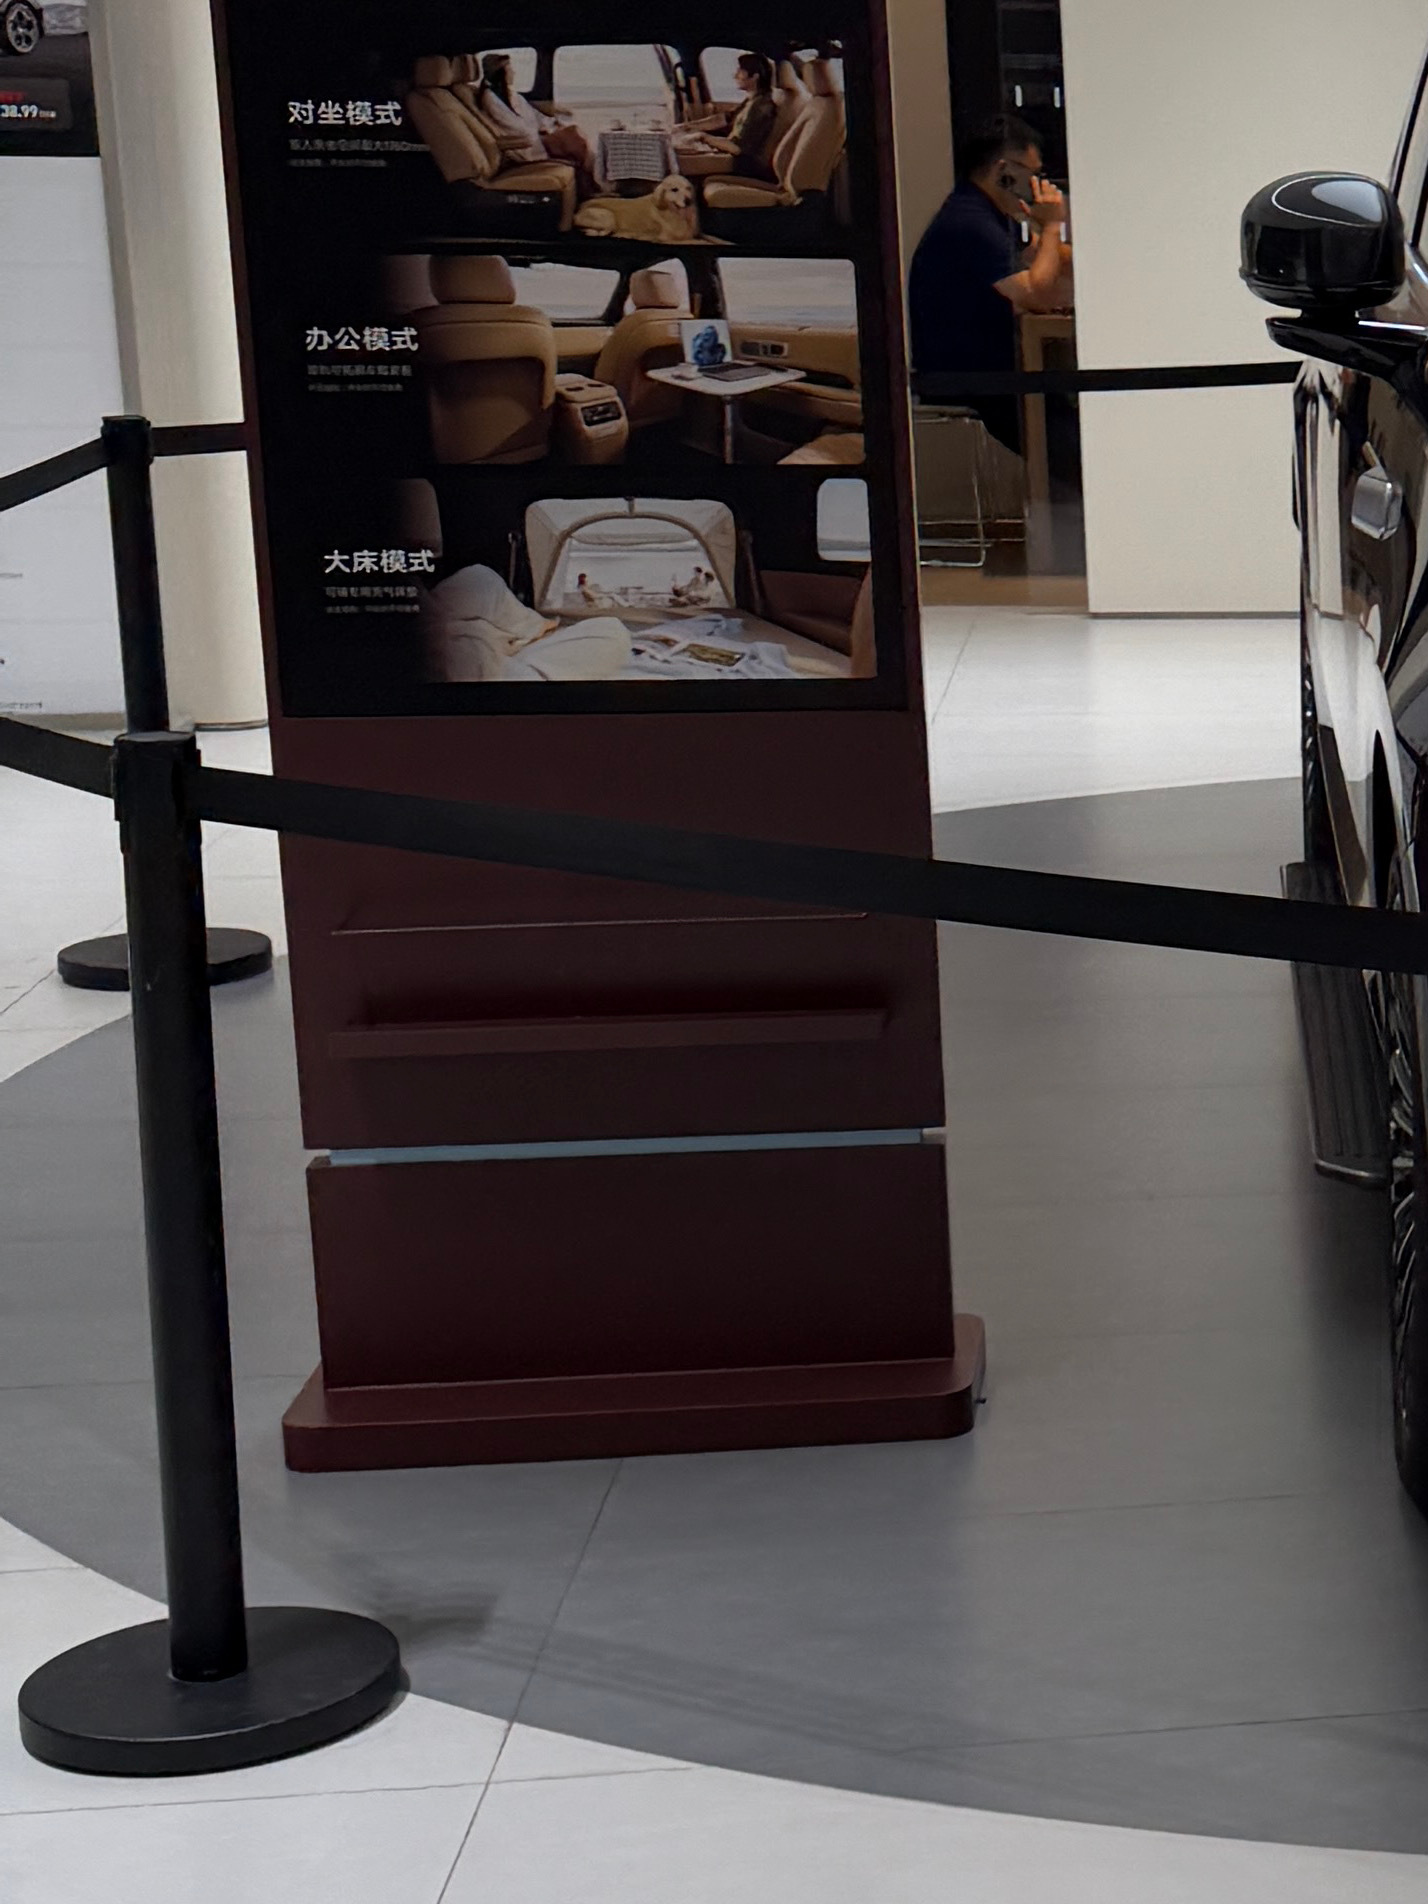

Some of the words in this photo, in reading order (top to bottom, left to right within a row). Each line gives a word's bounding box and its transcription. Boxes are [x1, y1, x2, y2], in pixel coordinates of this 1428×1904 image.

[288, 99, 402, 126] 对坐模式
[305, 326, 419, 351] 办公模式
[323, 549, 436, 574] 大床模式
